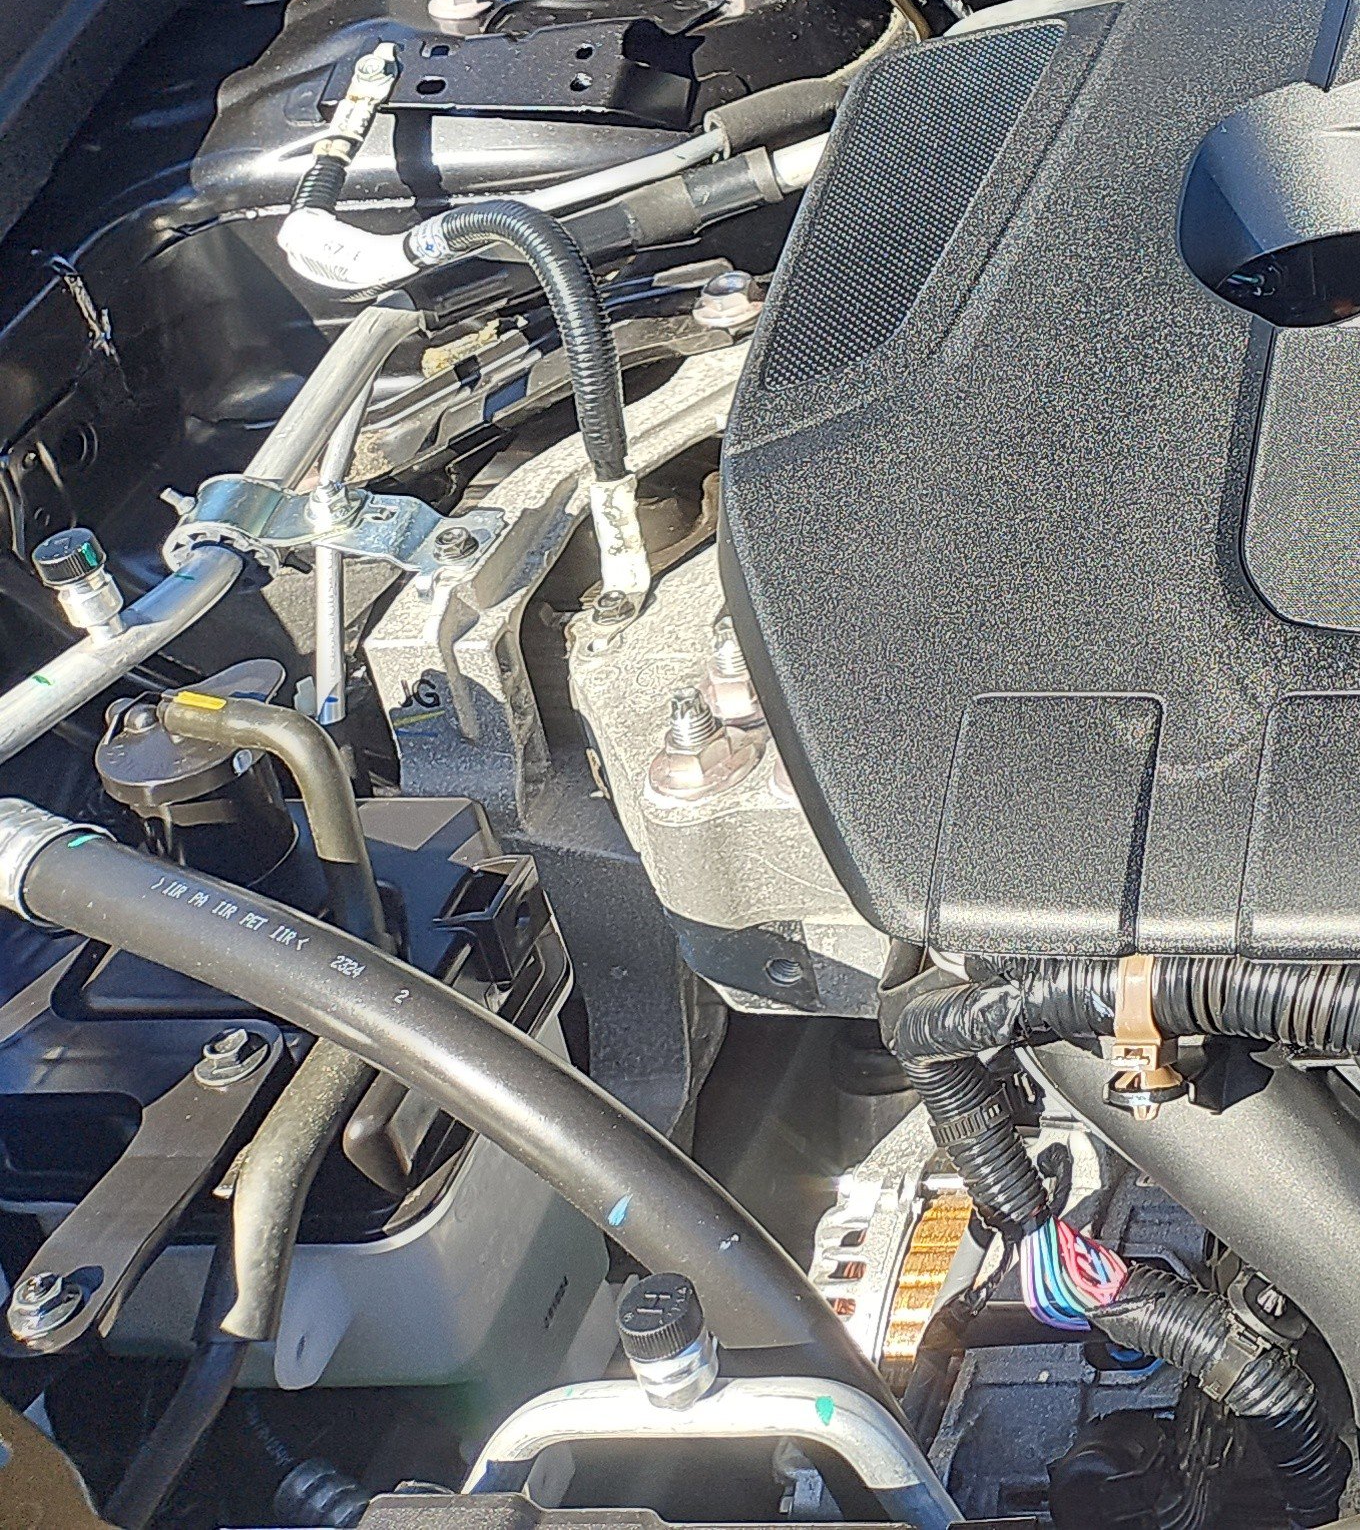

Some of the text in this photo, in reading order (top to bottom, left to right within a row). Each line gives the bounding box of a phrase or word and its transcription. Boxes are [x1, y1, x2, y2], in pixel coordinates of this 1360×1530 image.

[238, 912, 269, 931] PET
[330, 954, 367, 979] 2324
[394, 989, 410, 1004] 2
